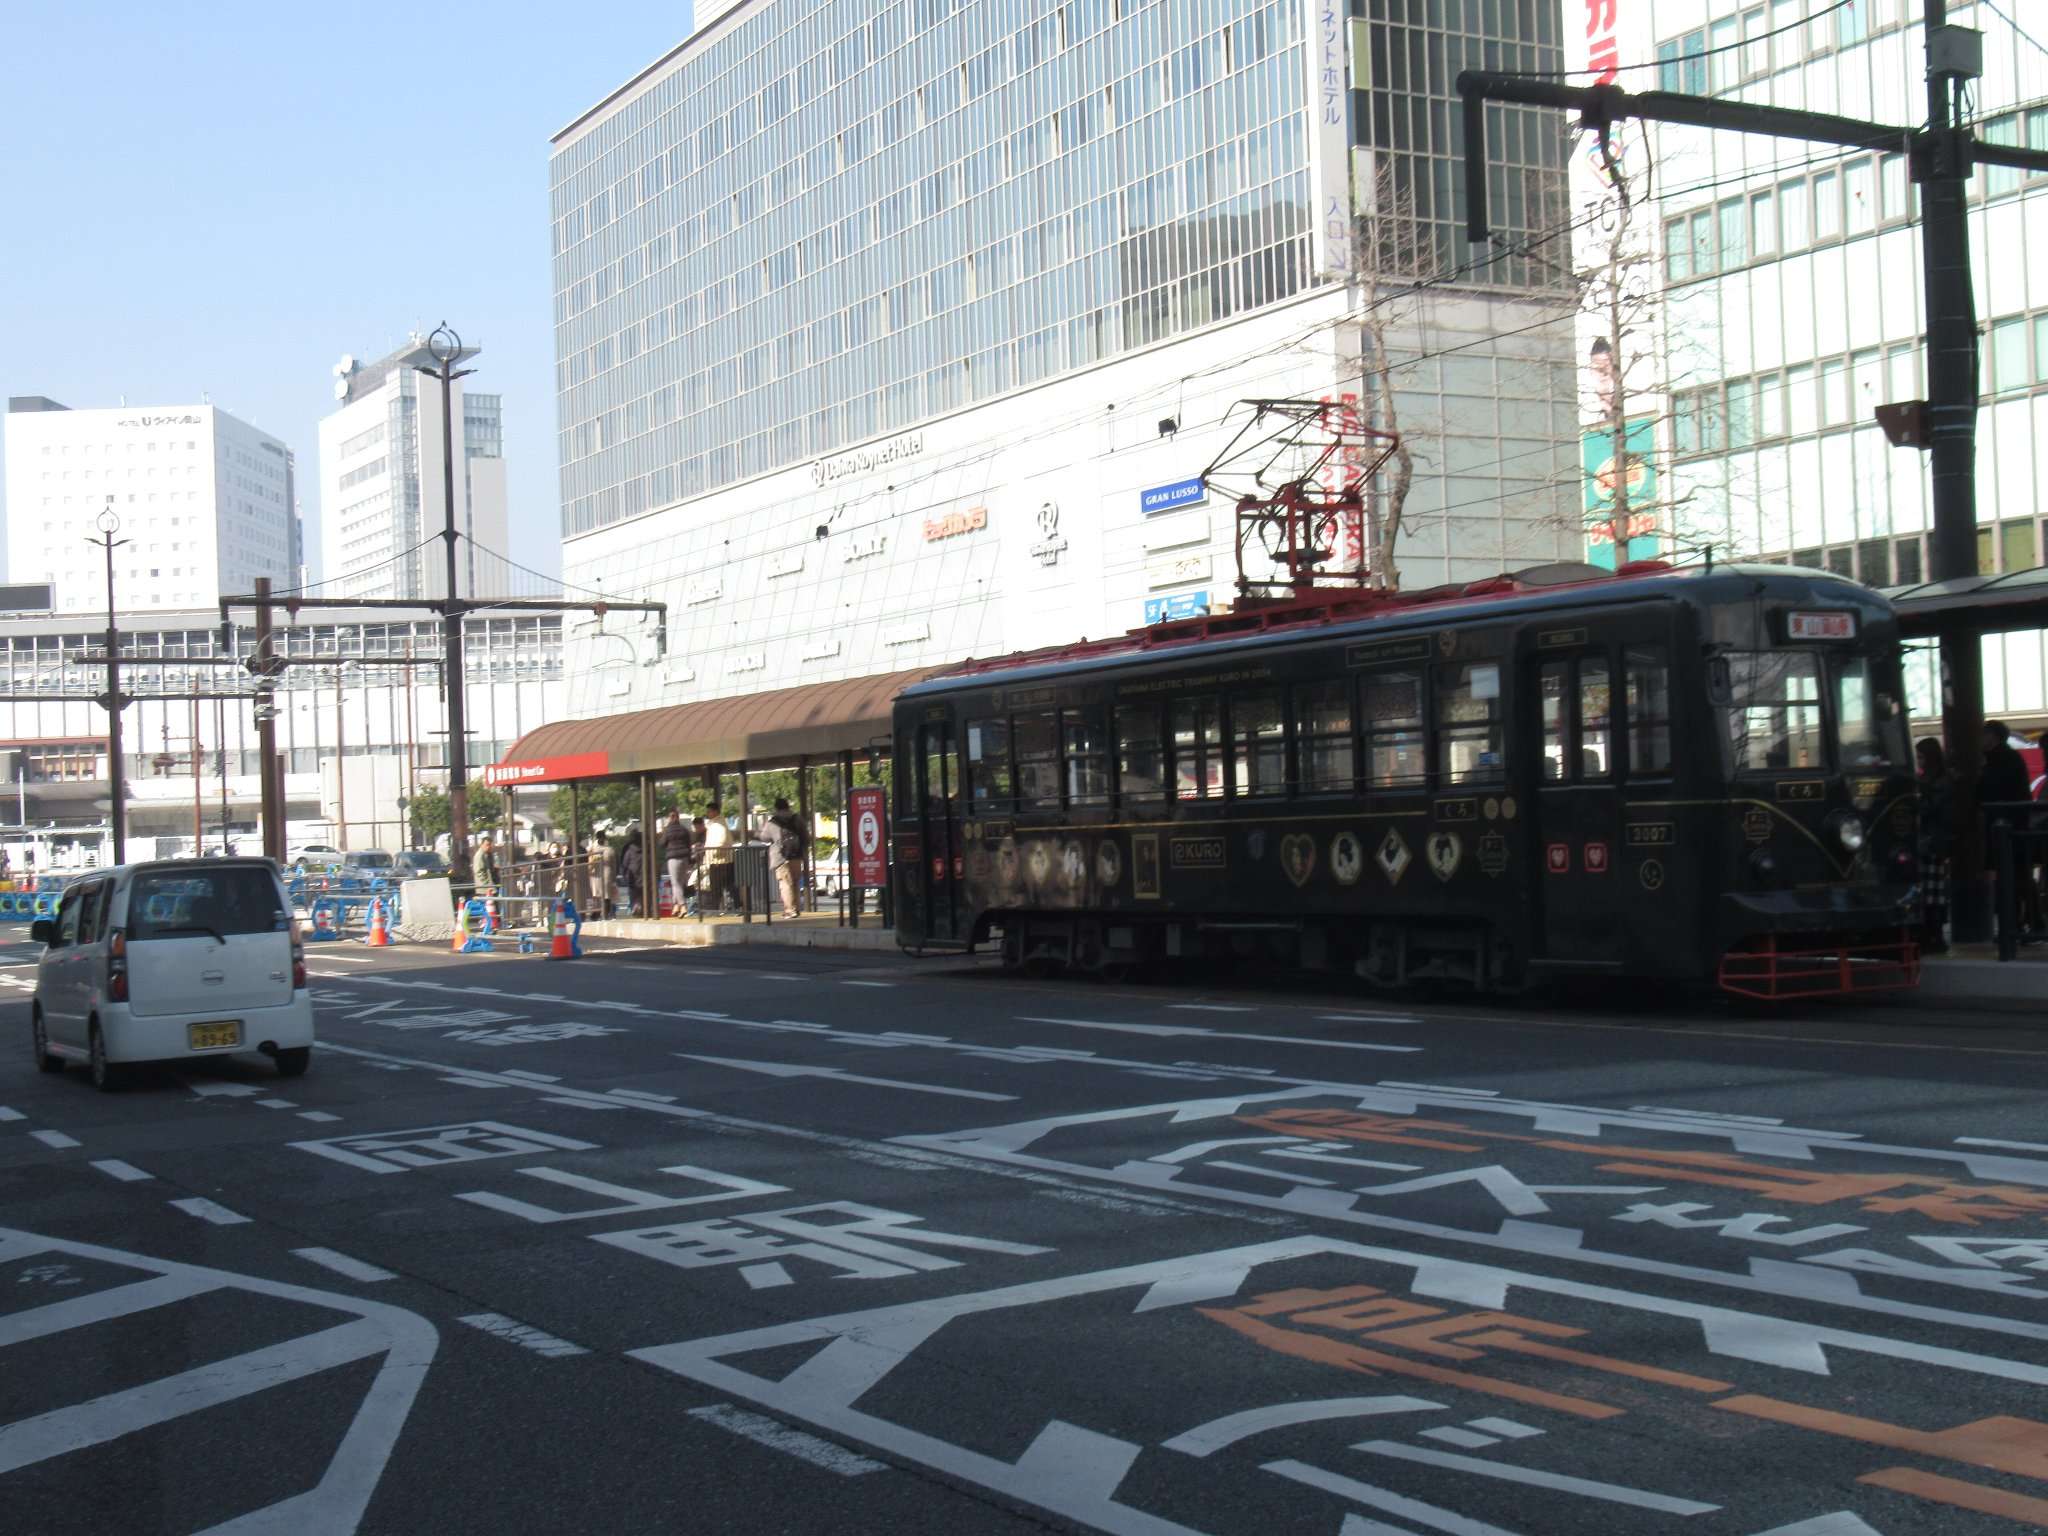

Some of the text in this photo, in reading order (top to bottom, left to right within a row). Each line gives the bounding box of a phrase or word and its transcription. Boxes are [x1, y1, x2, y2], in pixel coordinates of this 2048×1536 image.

[895, 432, 924, 460] Hotel
[1145, 485, 1199, 506] GRAN LUSSO
[286, 1121, 1058, 1290] 岡山駅
